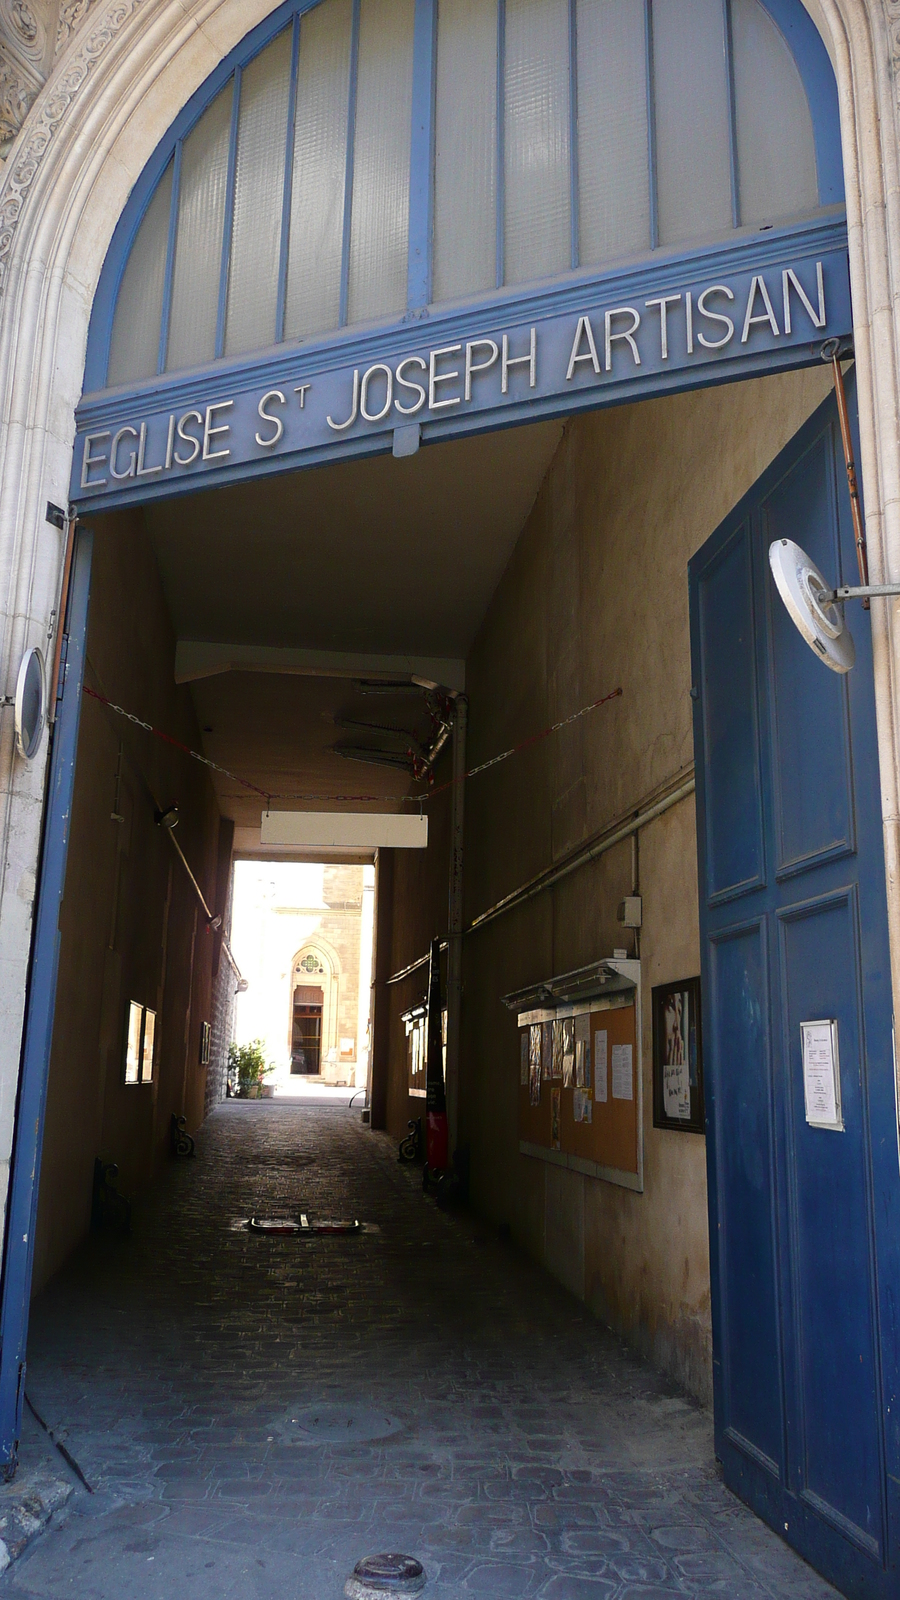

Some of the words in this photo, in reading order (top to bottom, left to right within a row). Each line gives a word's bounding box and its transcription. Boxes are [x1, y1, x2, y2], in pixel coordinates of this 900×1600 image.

[80, 400, 233, 488] EGLISE
[326, 328, 536, 430] JOSEPH
[566, 262, 826, 380] ARTISAN
